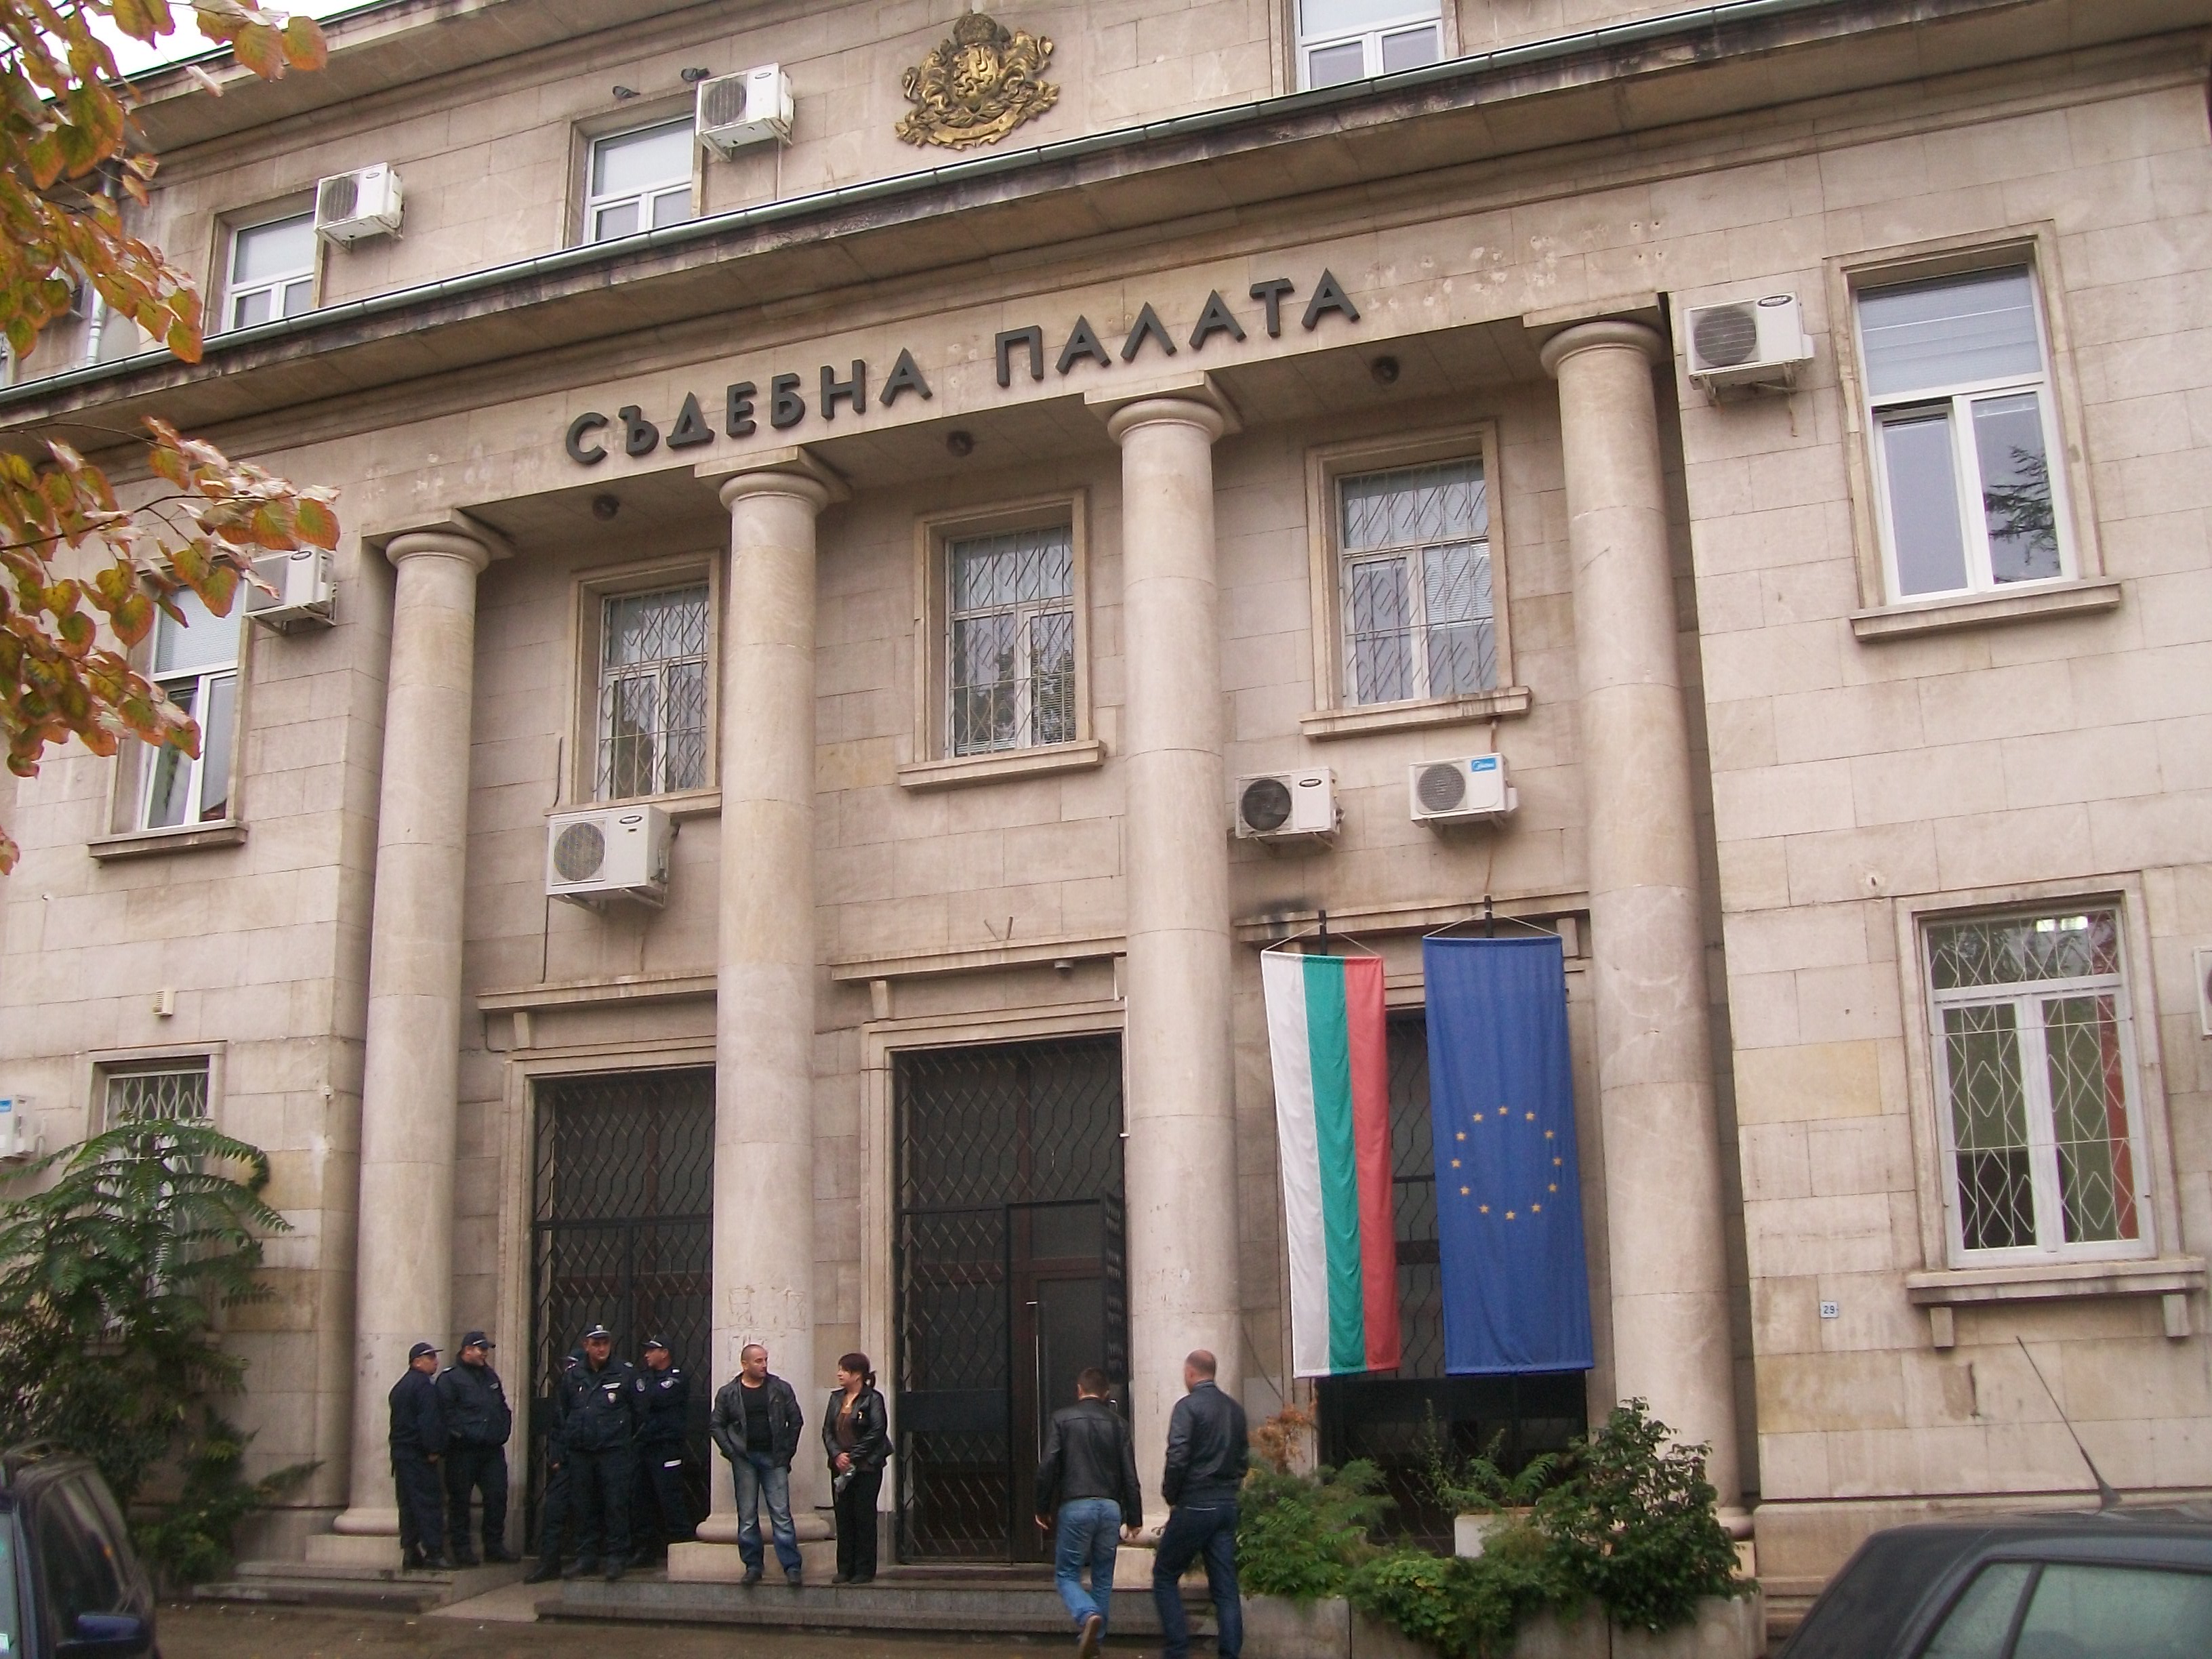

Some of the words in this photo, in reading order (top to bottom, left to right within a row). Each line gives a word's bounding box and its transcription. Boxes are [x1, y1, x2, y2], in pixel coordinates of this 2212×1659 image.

[565, 347, 933, 466] СЪДЕБНА
[995, 268, 1360, 388] ПАЛАТА
[1824, 1305, 1835, 1314] 29
